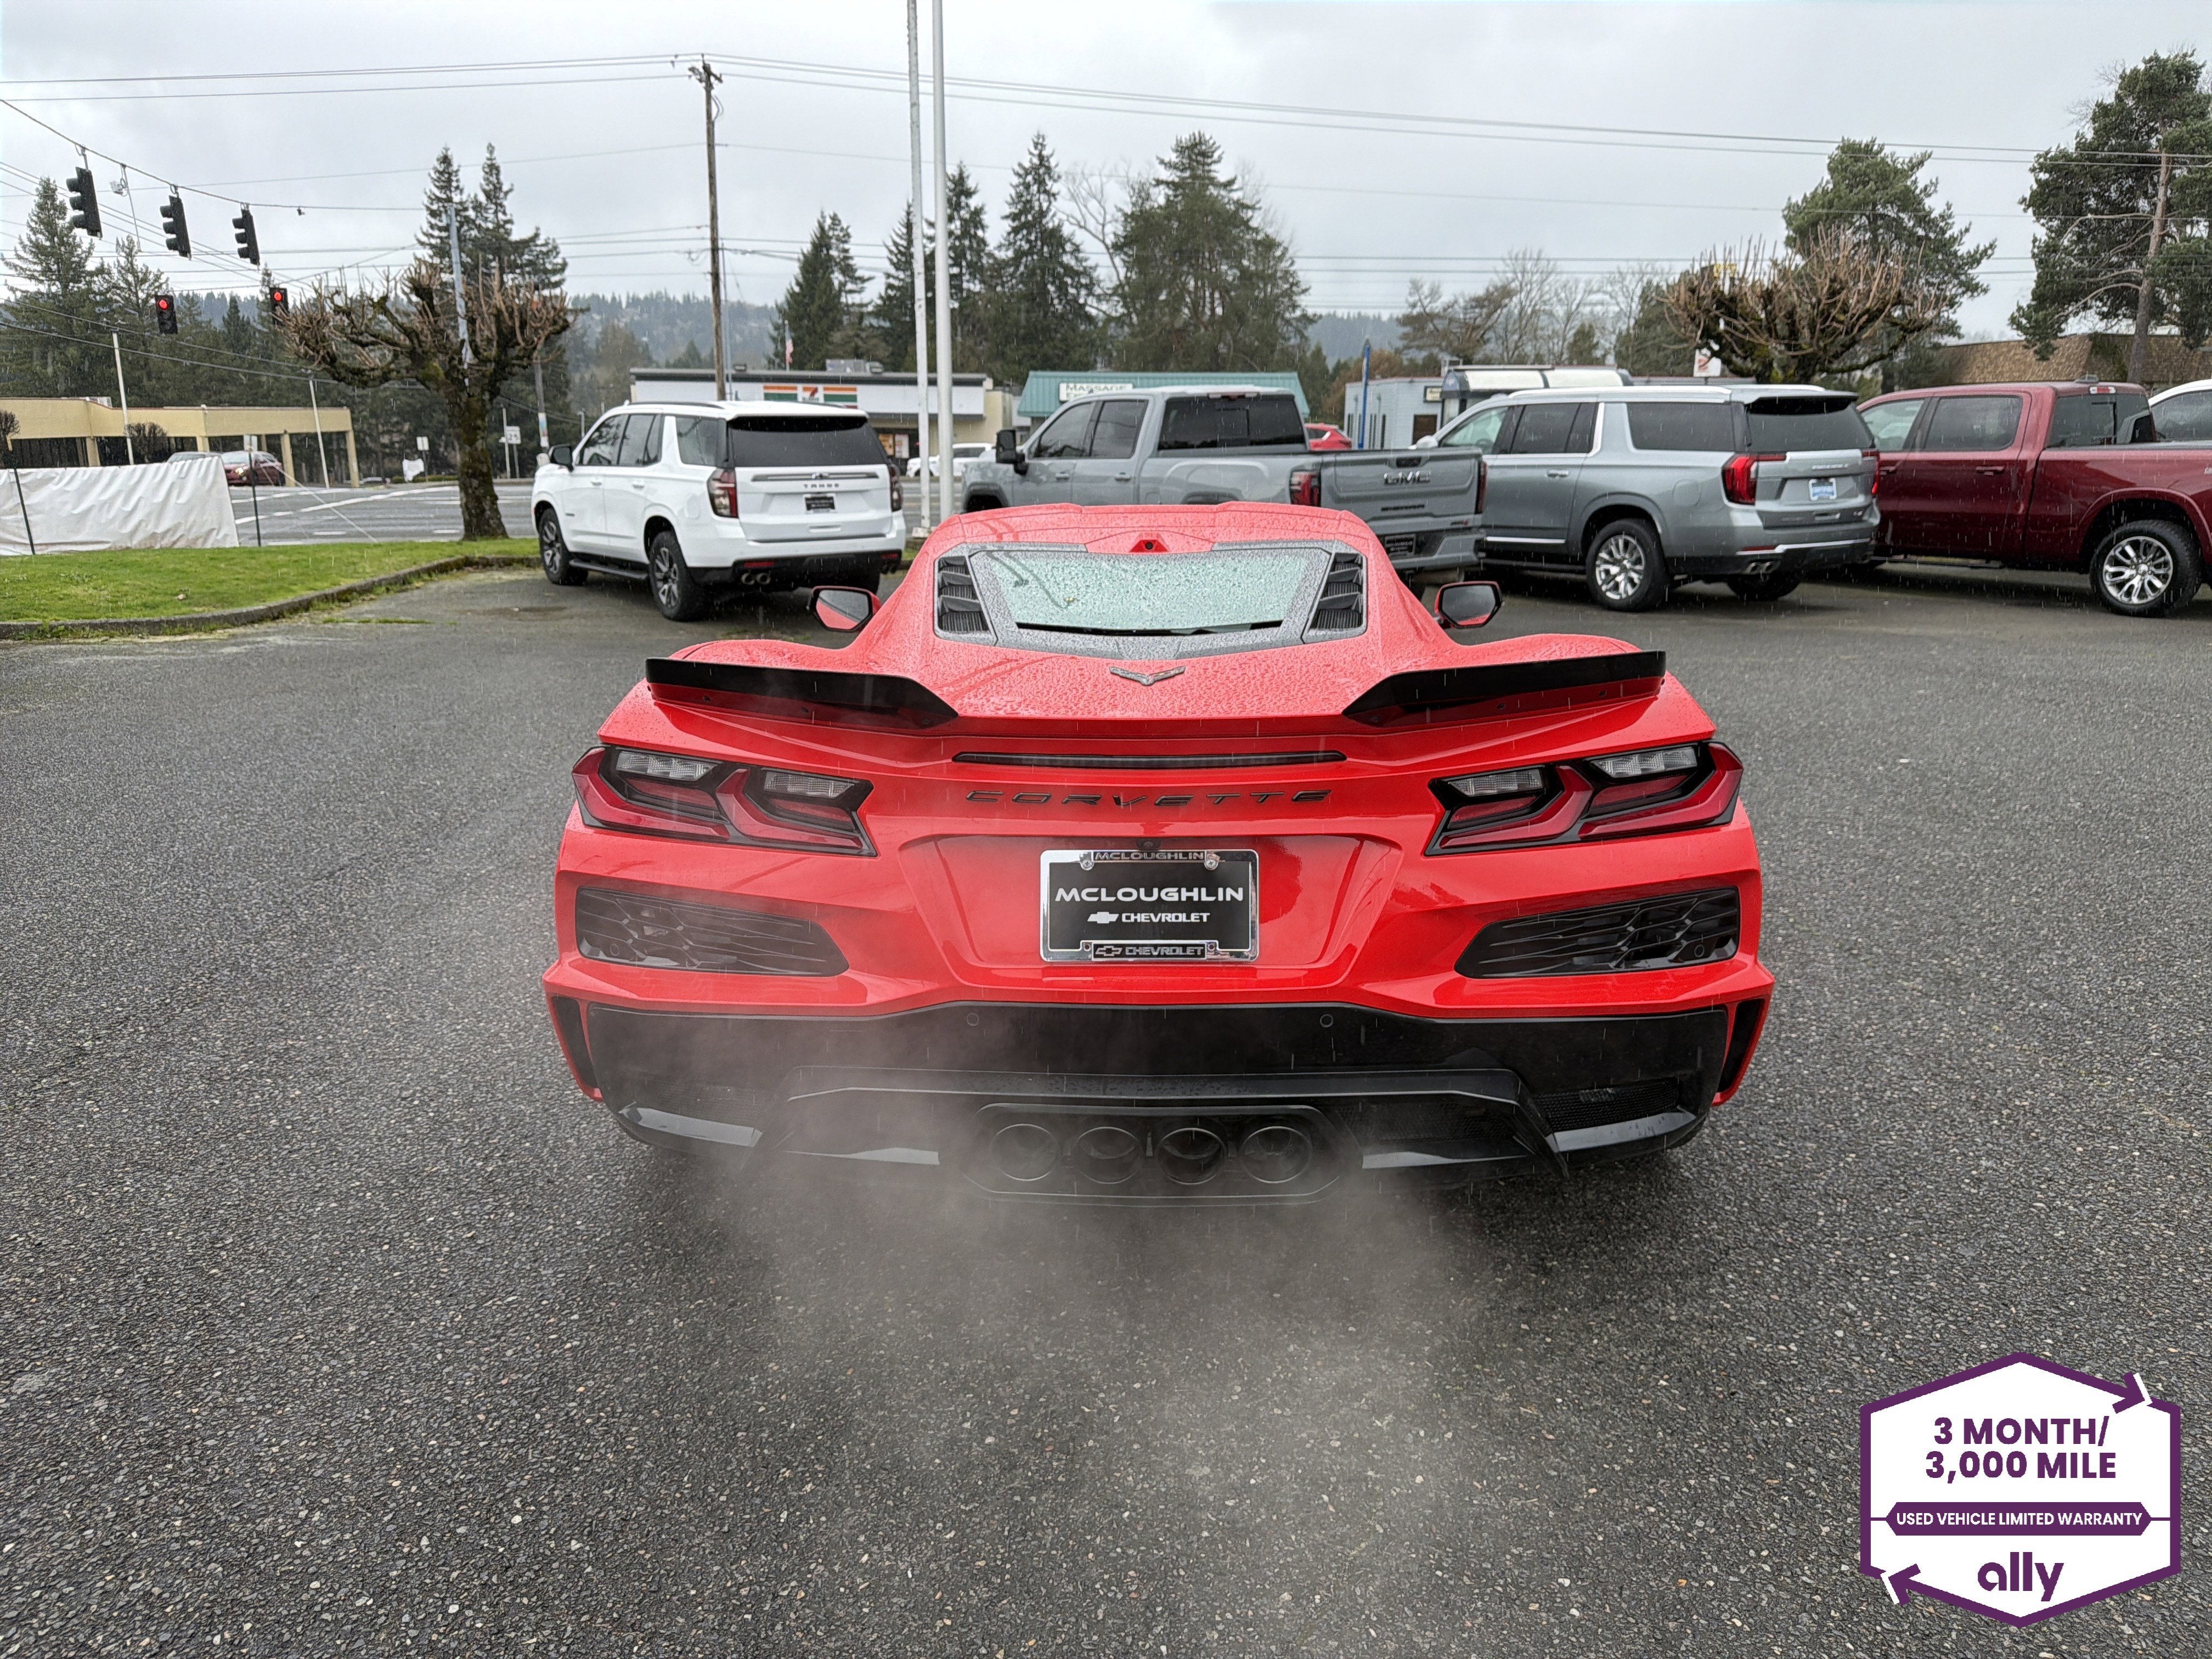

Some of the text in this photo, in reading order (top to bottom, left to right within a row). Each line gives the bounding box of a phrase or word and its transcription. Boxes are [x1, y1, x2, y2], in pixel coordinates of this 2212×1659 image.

[1384, 471, 1430, 485] GMC
[966, 789, 1331, 806] CORVETTE
[1094, 852, 1204, 860] MCLOUGHLIN
[1054, 887, 1243, 902] MCLOUGHLIN
[1121, 912, 1211, 922] CHEVROLET
[1125, 946, 1204, 956] CHEVROLET
